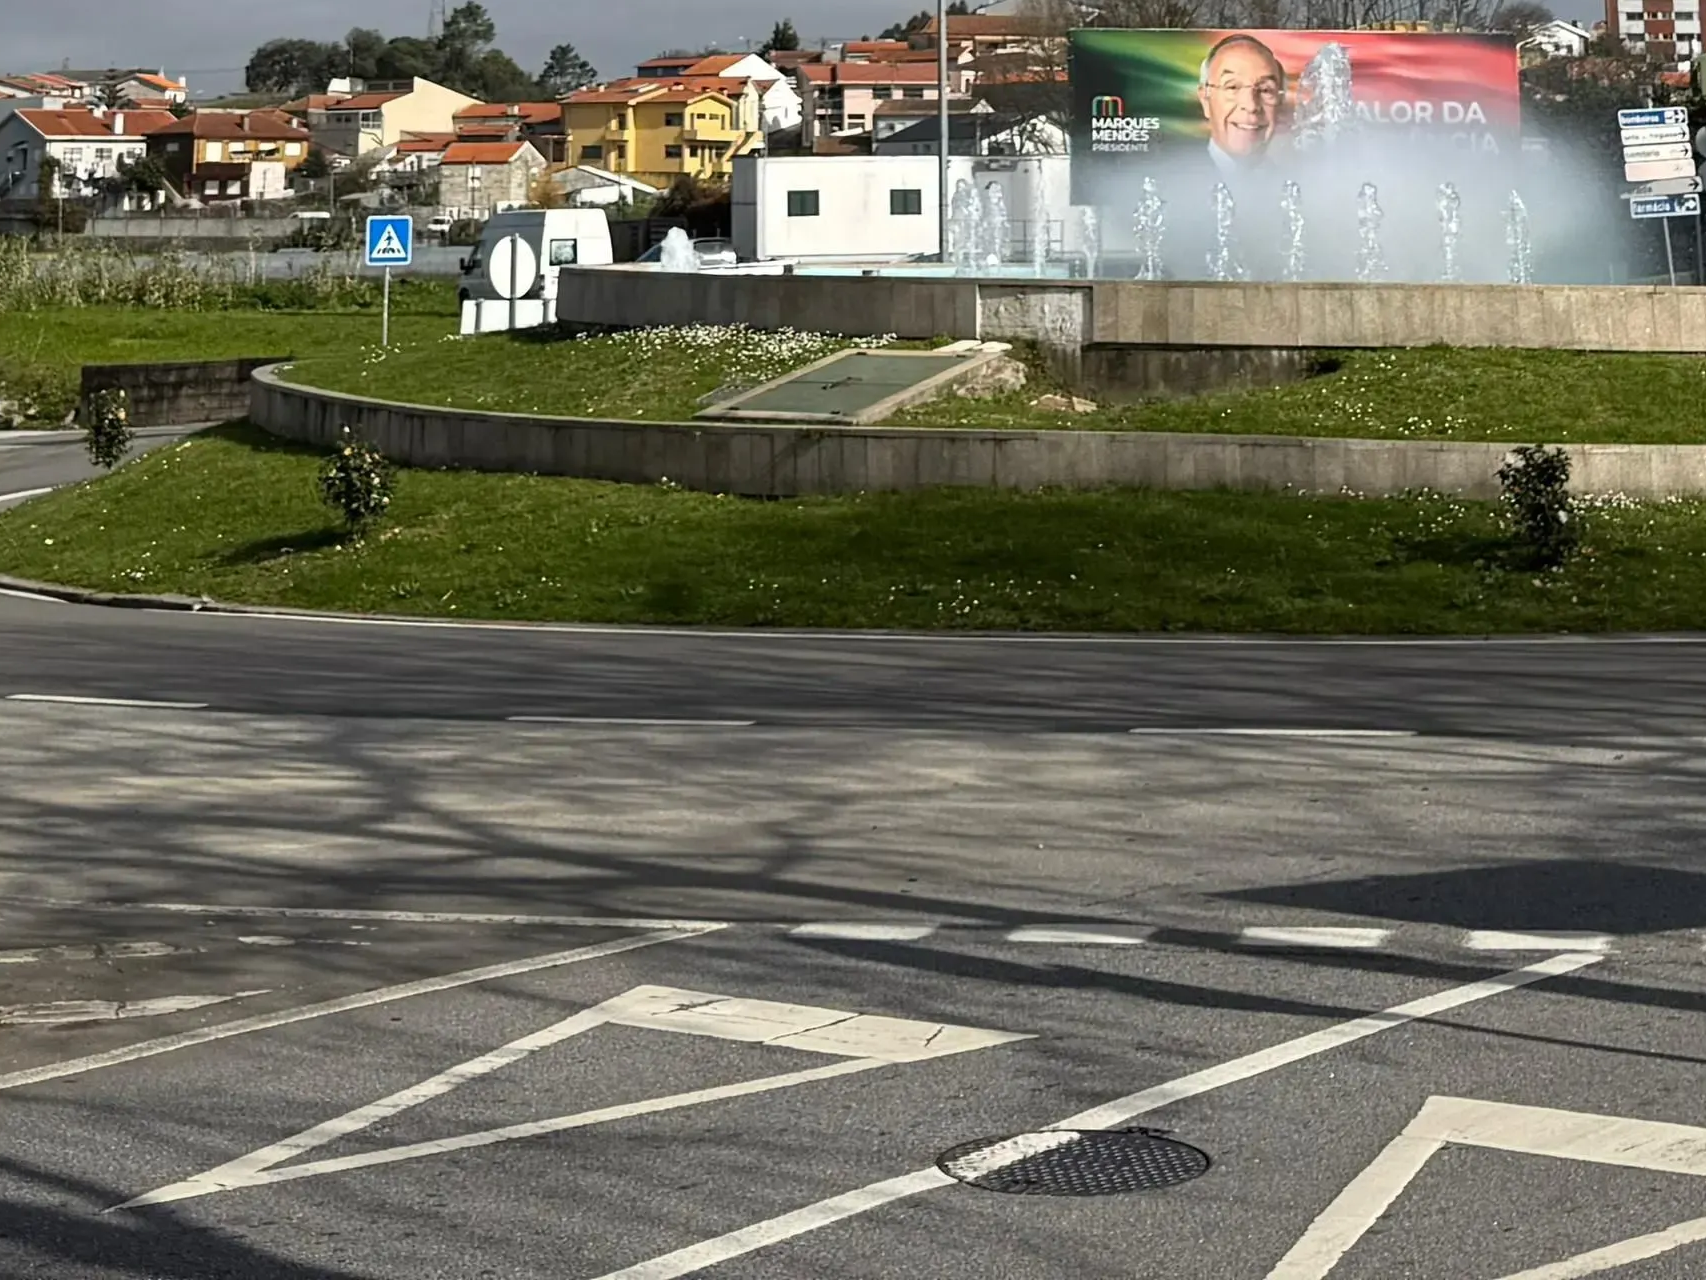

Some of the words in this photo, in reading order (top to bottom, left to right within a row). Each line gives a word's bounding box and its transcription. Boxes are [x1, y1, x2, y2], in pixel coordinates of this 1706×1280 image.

[1349, 101, 1434, 124] ALOR
[1443, 101, 1487, 124] DA
[1092, 117, 1160, 130] MARQUES
[1092, 130, 1150, 141] MENDES
[1092, 143, 1150, 152] PRESIDENTE
